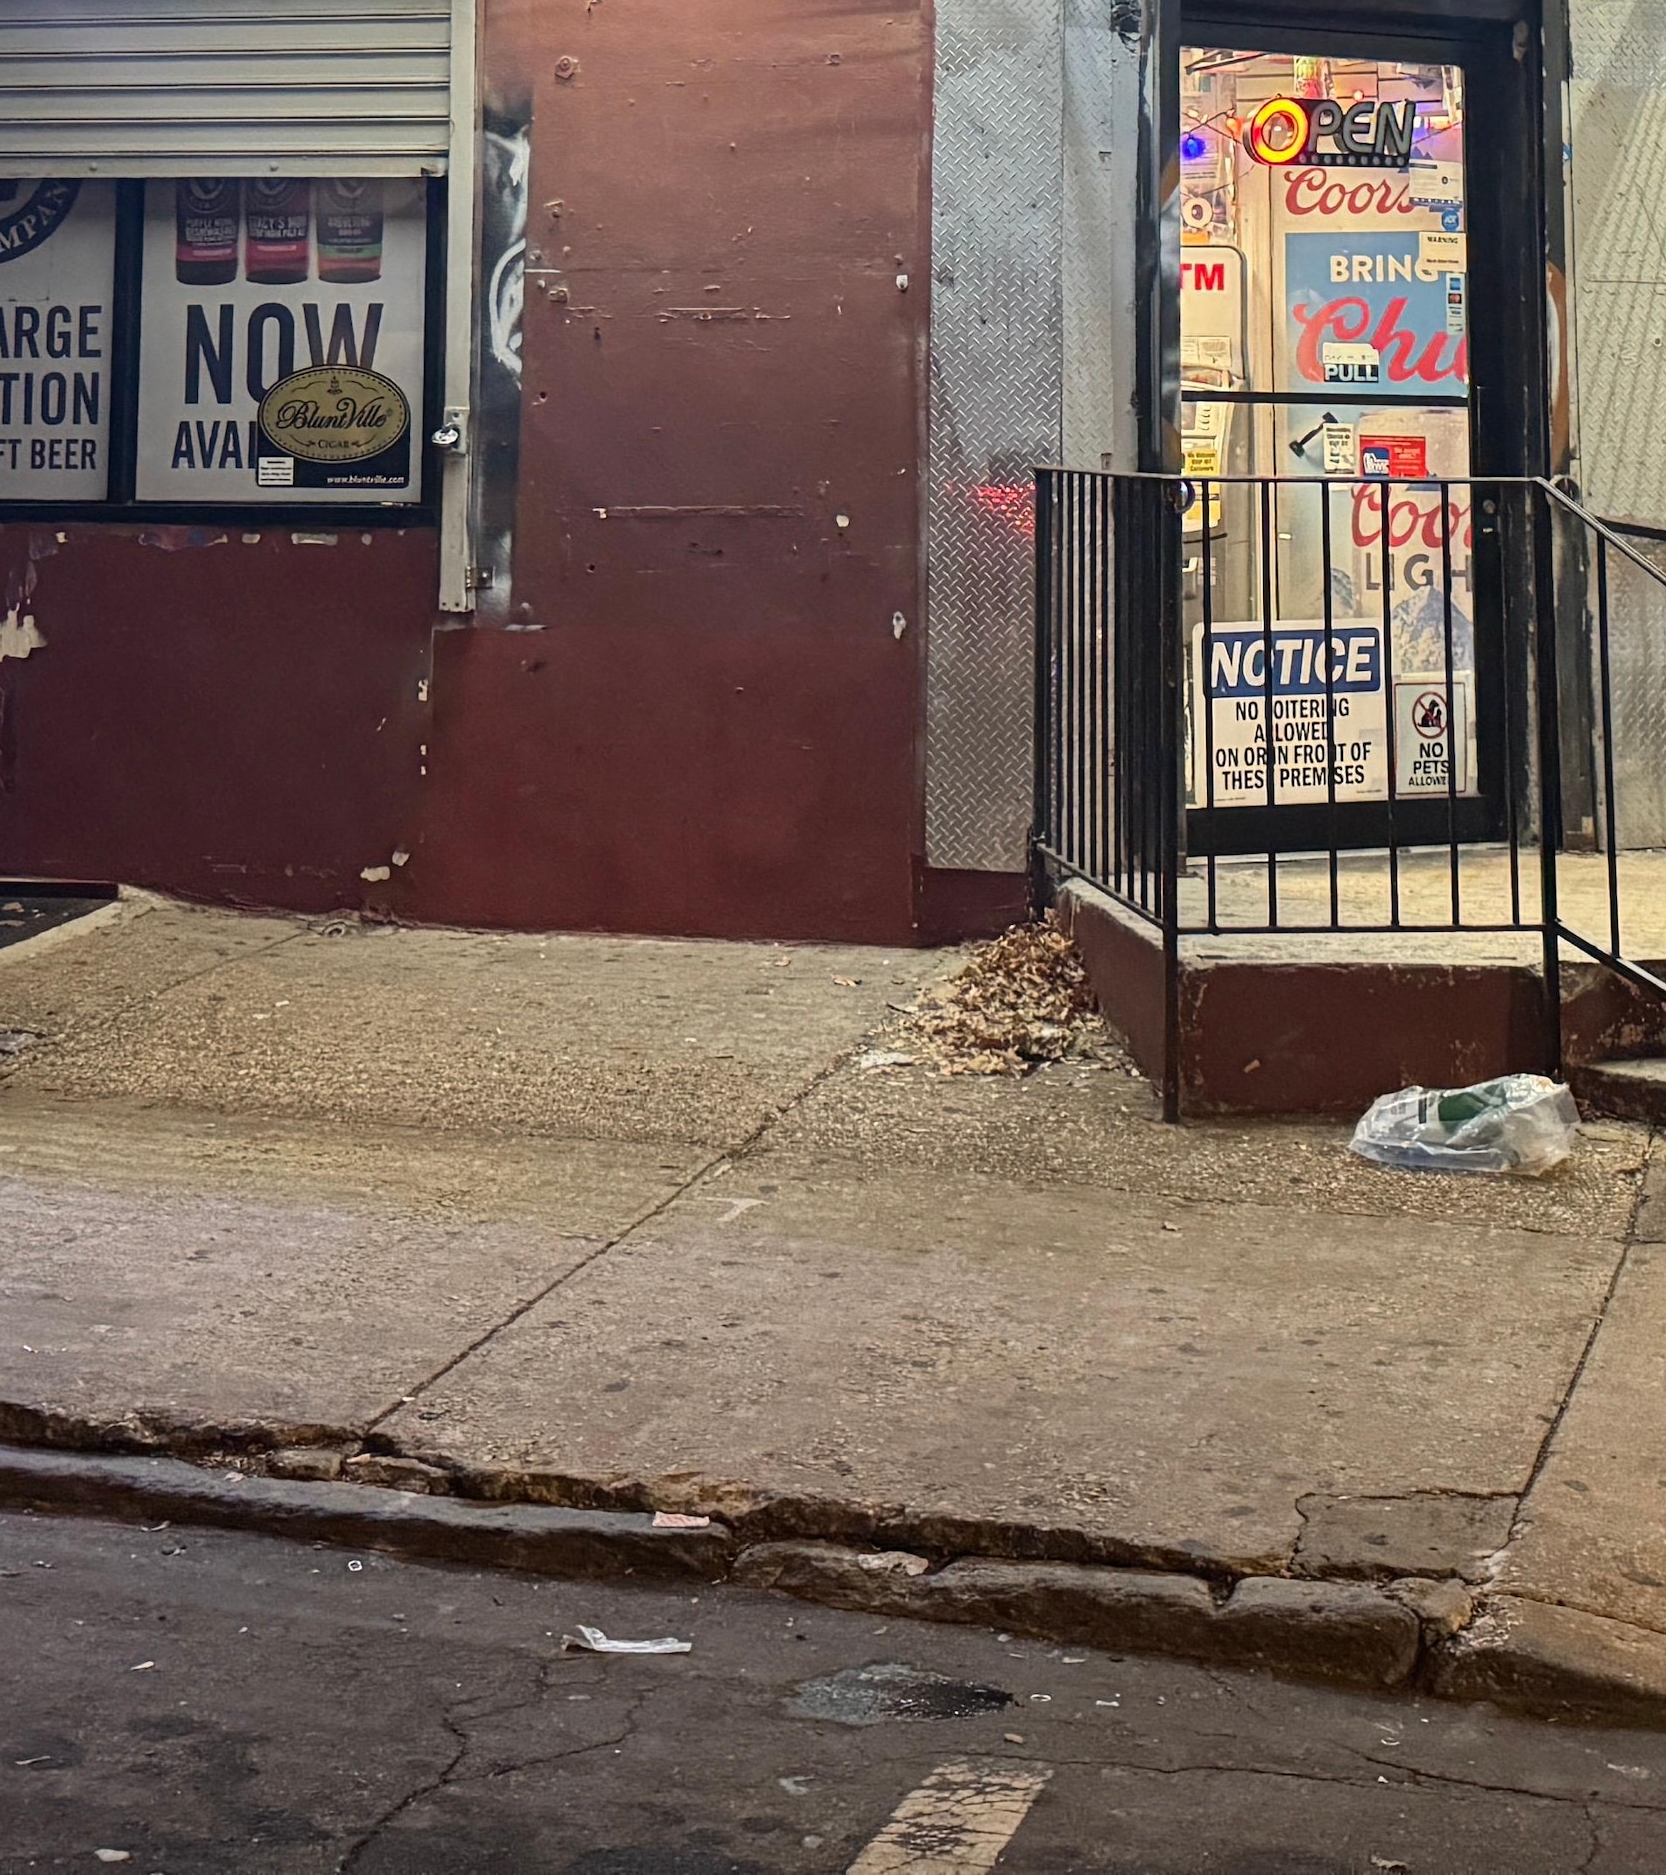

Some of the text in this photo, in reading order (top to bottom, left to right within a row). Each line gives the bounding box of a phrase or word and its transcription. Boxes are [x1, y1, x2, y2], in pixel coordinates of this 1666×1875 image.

[1252, 98, 1416, 163] OPEN
[1180, 263, 1225, 291] TM
[184, 302, 384, 406] NOW
[1324, 364, 1378, 382] PULL
[276, 396, 386, 431] BluntVille
[30, 437, 97, 470] BEER
[317, 439, 351, 450] CIGAR
[1211, 636, 1375, 688] NOTICE
[1236, 701, 1258, 721] NO
[1216, 747, 1239, 767] ON
[1244, 746, 1268, 767] OR
[1350, 741, 1372, 762] OF
[1419, 742, 1444, 758] NO
[1222, 765, 1365, 790] THES PREMSES
[1413, 760, 1451, 774] PETS
[1408, 776, 1447, 786] ALLOWE
